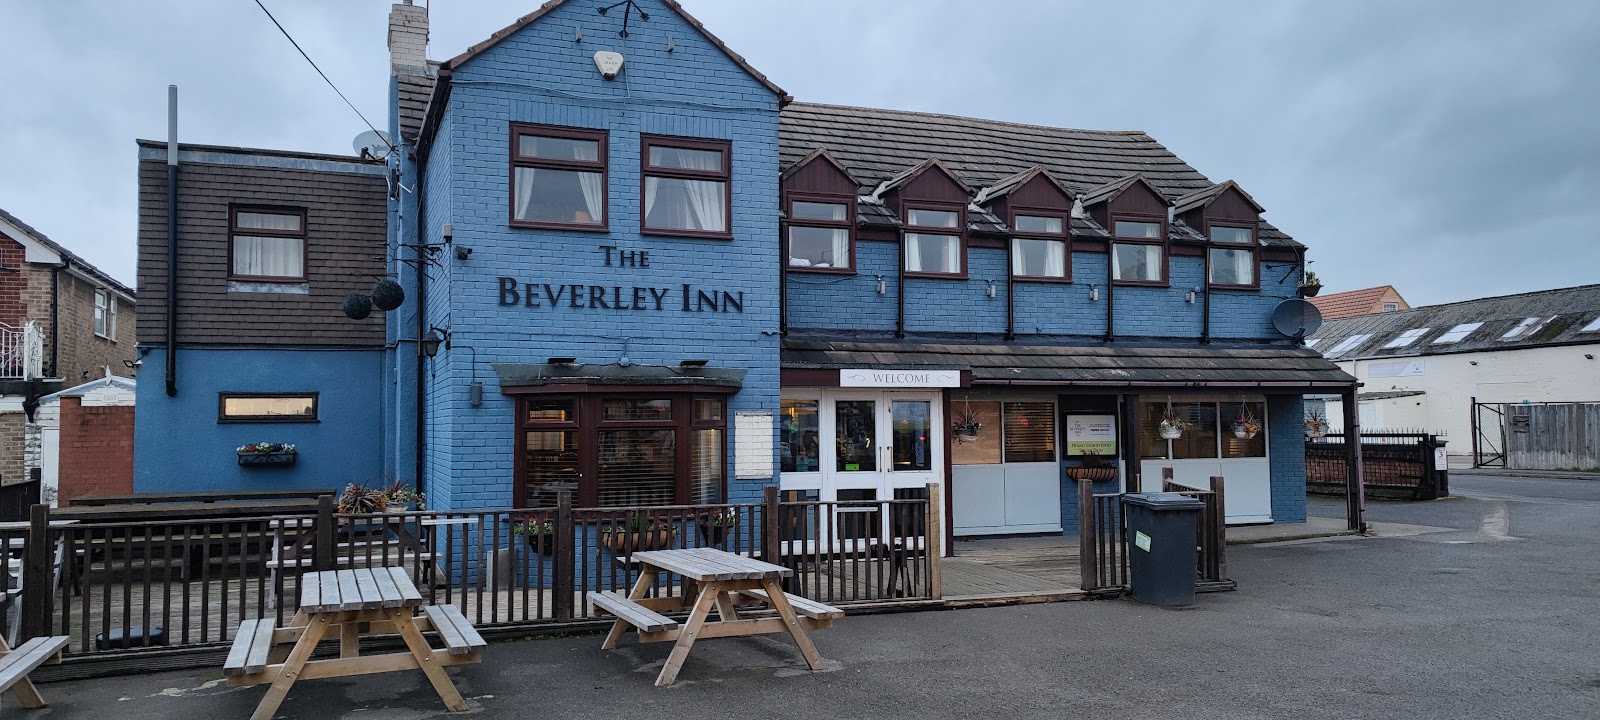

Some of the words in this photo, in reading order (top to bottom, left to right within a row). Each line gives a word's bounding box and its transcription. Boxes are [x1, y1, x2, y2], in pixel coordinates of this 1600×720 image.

[599, 245, 650, 267] THE
[496, 276, 669, 310] BEVERLEY
[682, 284, 743, 313] INN
[873, 373, 931, 383] WELCOME
